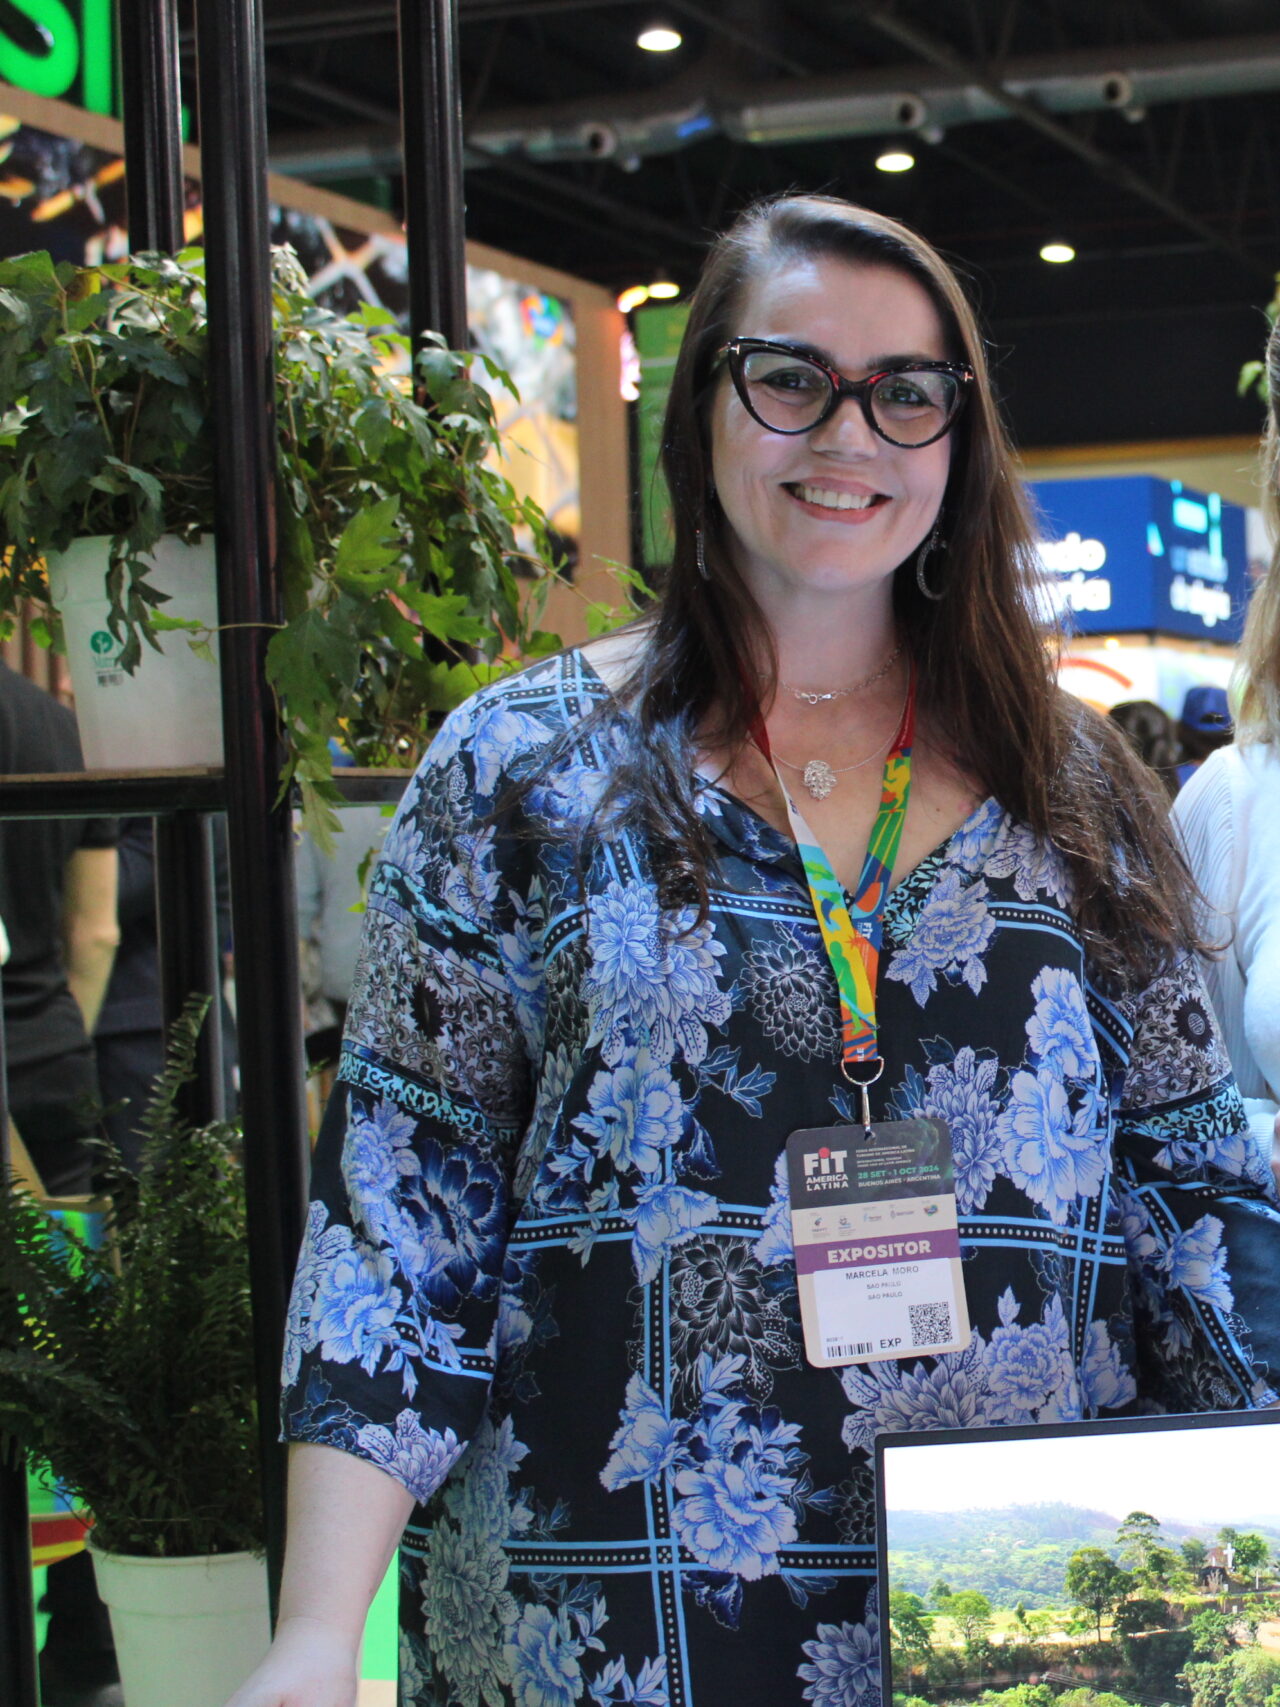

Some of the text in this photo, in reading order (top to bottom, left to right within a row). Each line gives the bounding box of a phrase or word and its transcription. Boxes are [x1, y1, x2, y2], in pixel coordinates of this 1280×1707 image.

[870, 1170, 886, 1178] SET
[899, 1167, 916, 1175] OCT
[806, 1174, 849, 1184] AMERICA
[858, 1179, 884, 1188] BUENOS
[884, 1177, 902, 1185] AIRES
[906, 1174, 941, 1183] ARGENTINA
[806, 1182, 849, 1192] LATINA
[827, 1240, 932, 1264] EXPOSITOR
[846, 1265, 919, 1280] MARCELA MORO
[882, 1291, 903, 1299] PAULO
[880, 1338, 902, 1349] EXP
